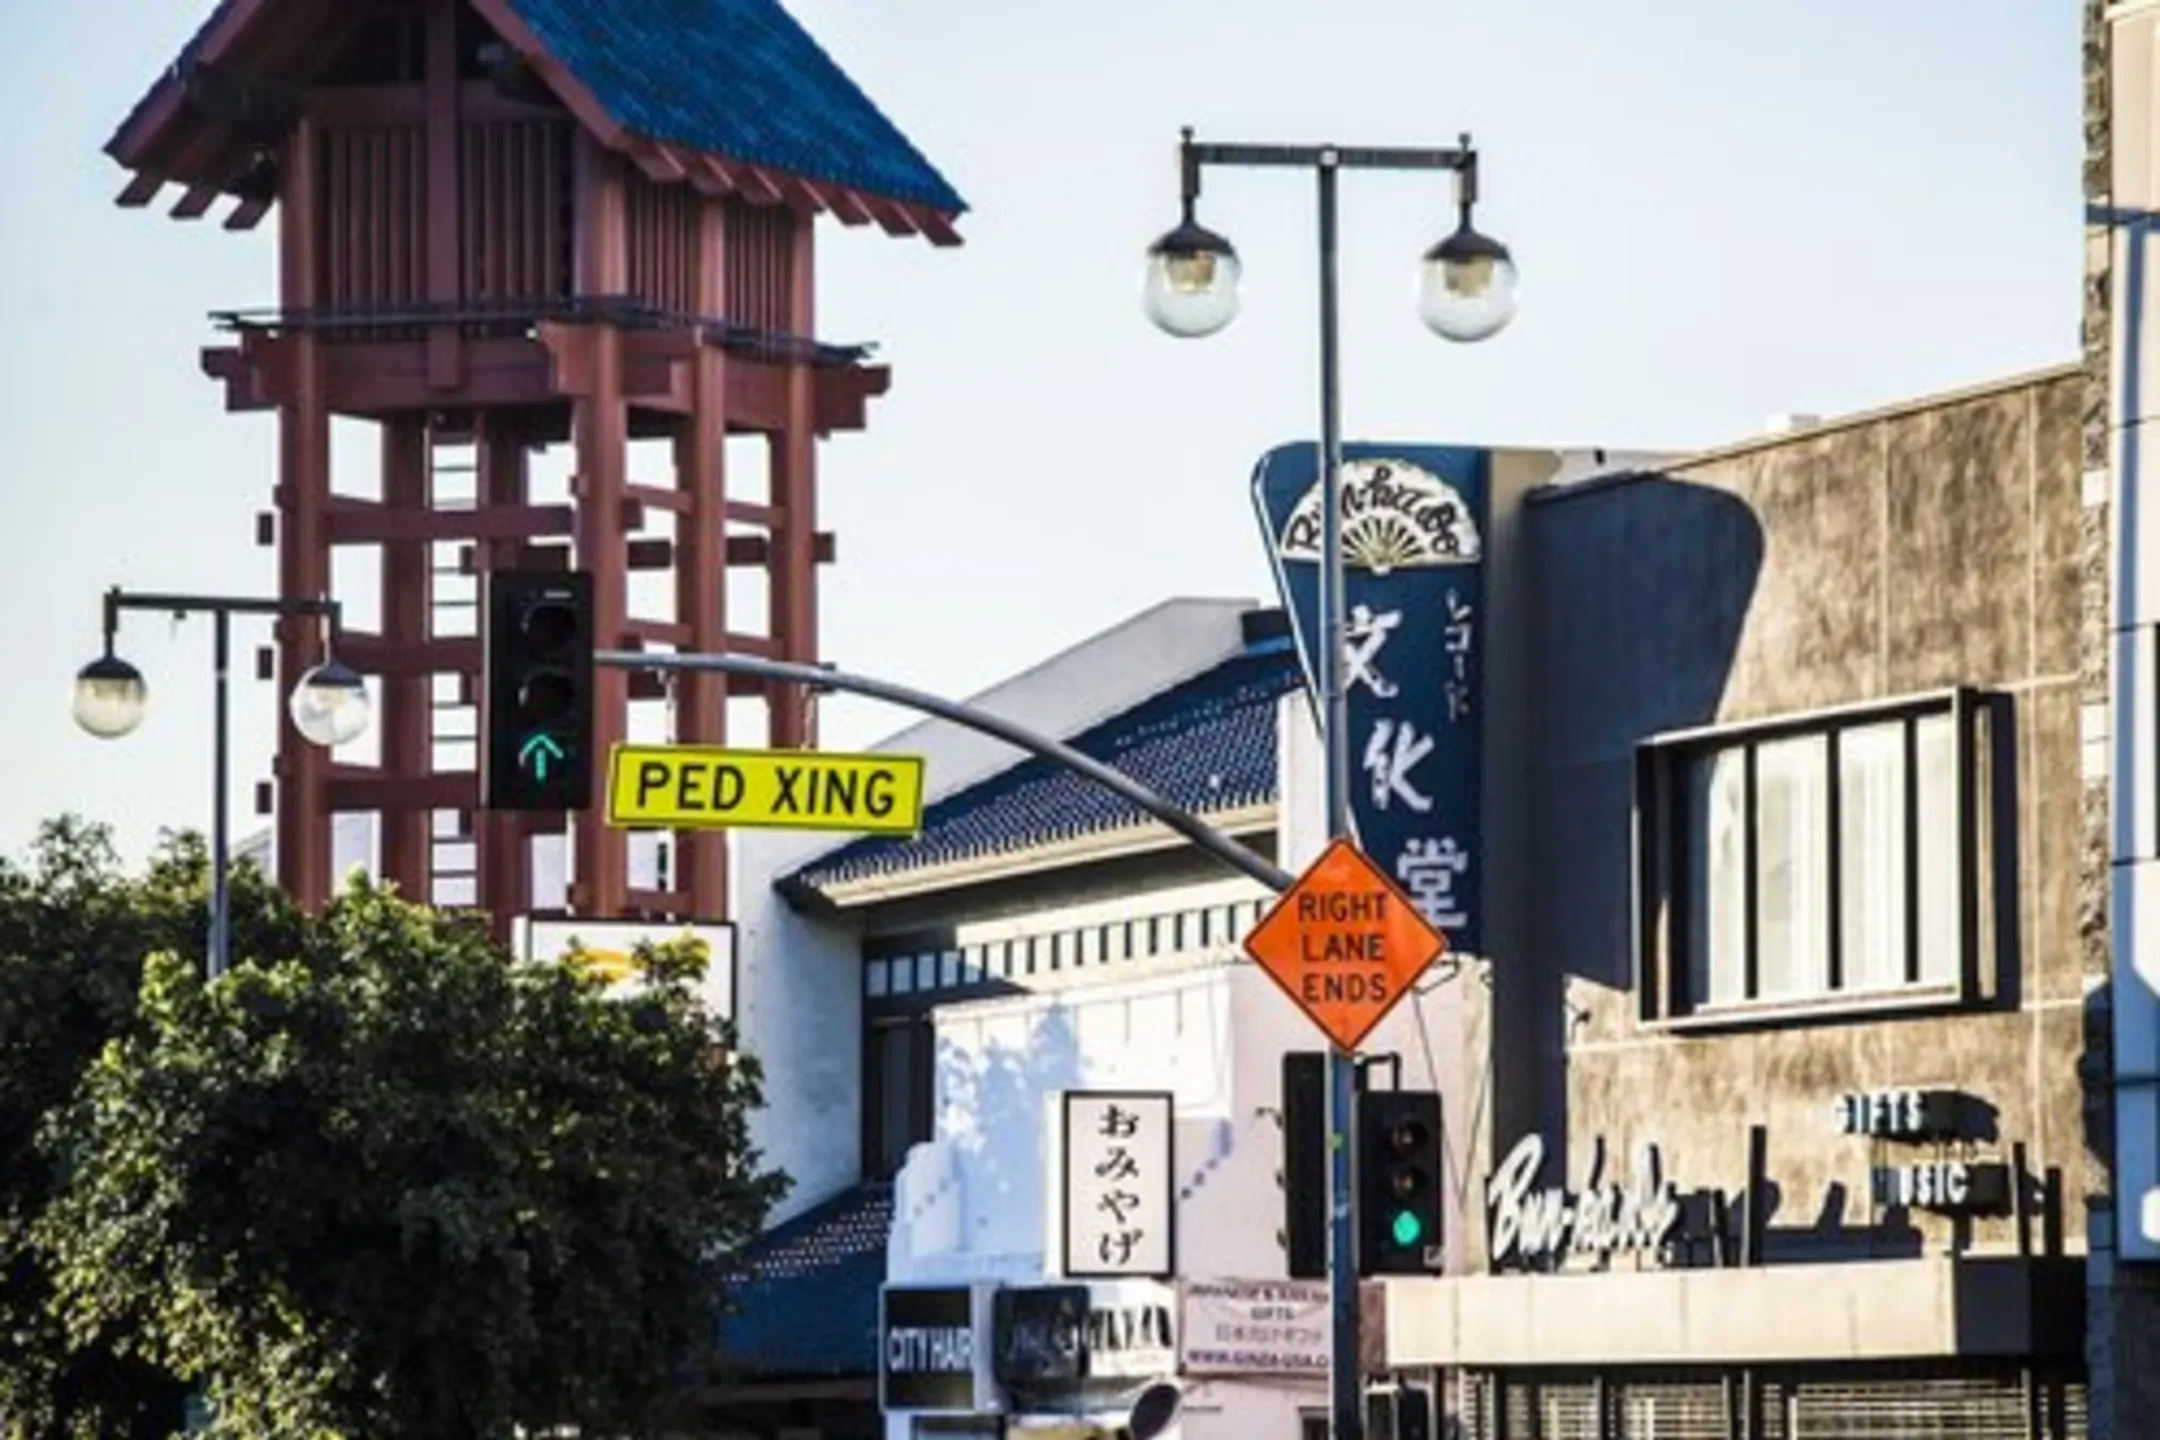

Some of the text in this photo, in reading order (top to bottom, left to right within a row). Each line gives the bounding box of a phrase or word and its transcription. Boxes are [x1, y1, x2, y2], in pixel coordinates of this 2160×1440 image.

[1343, 604, 1468, 928] 文化堂
[637, 761, 895, 818] PED XING
[1298, 891, 1387, 922] RIGHT
[1302, 934, 1386, 962] LANE
[1302, 973, 1387, 1003] ENDS
[1834, 1088, 1922, 1133] GIFTS
[1094, 1103, 1144, 1266] おみやげ
[888, 1326, 928, 1372] CITY
